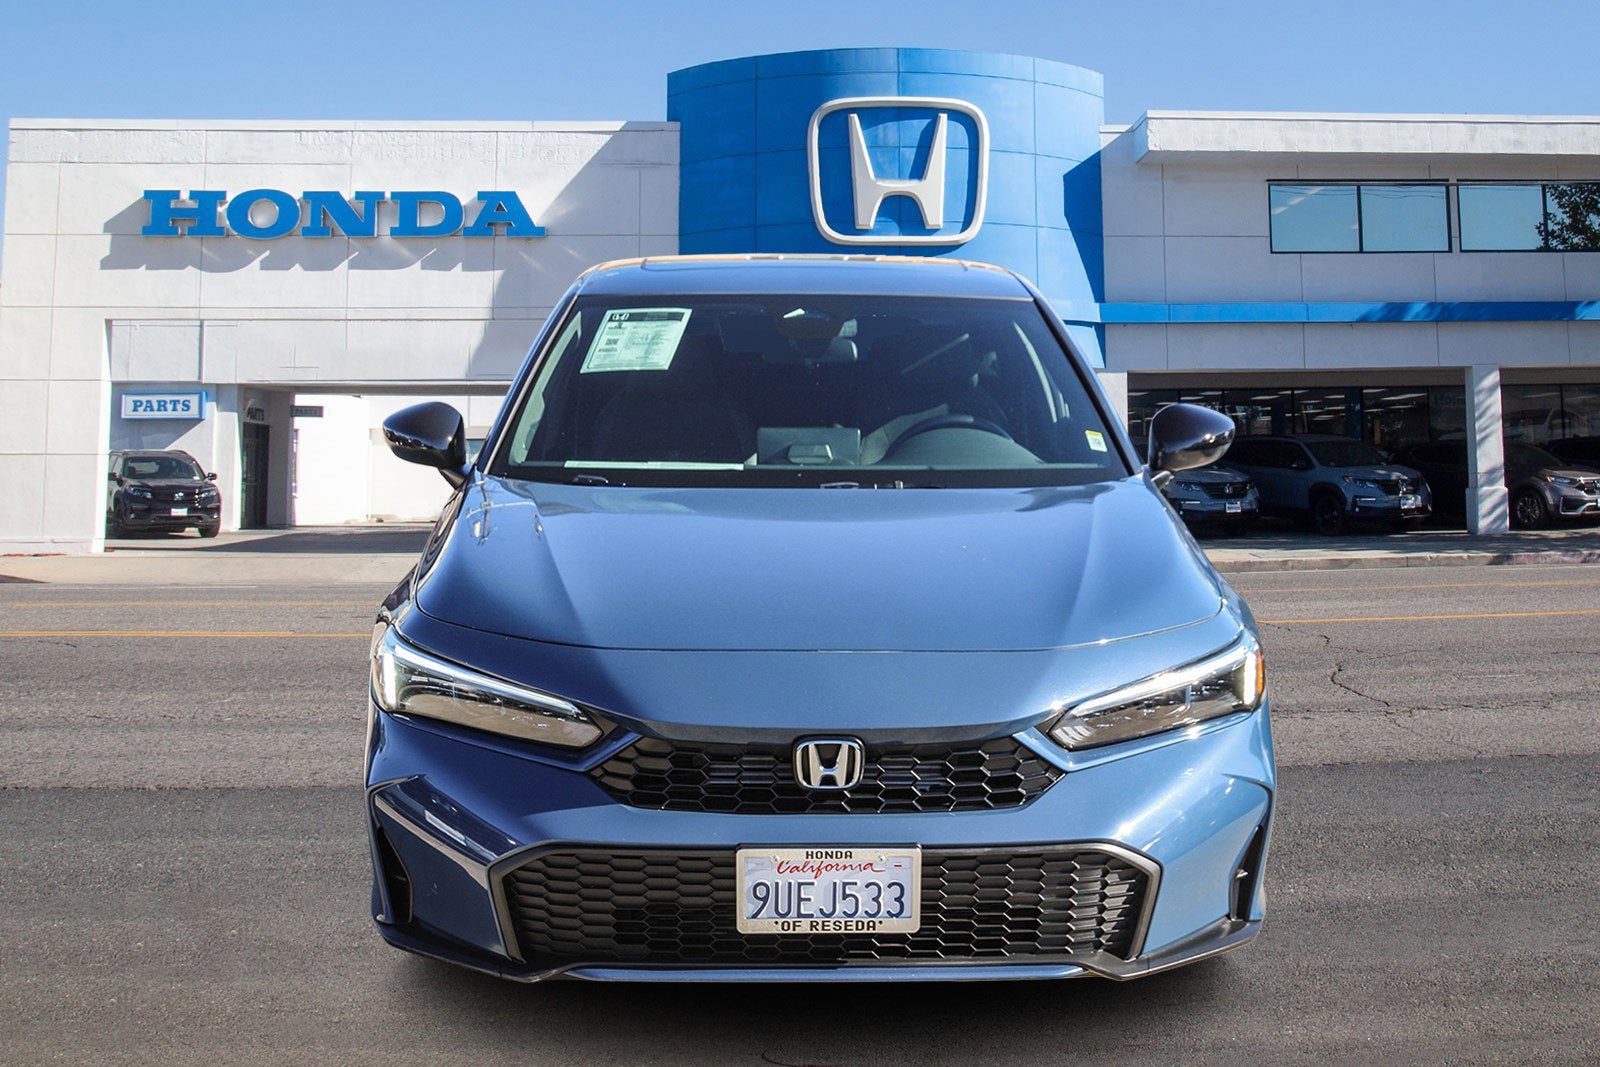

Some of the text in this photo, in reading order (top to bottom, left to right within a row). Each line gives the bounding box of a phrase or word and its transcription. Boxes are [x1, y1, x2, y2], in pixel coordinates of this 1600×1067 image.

[142, 189, 548, 239] HONDA
[132, 399, 191, 412] PARTS
[805, 850, 853, 860] HONDA
[777, 860, 885, 879] California
[751, 881, 906, 918] 9UEJ533
[781, 920, 877, 931] OF RESEDA
